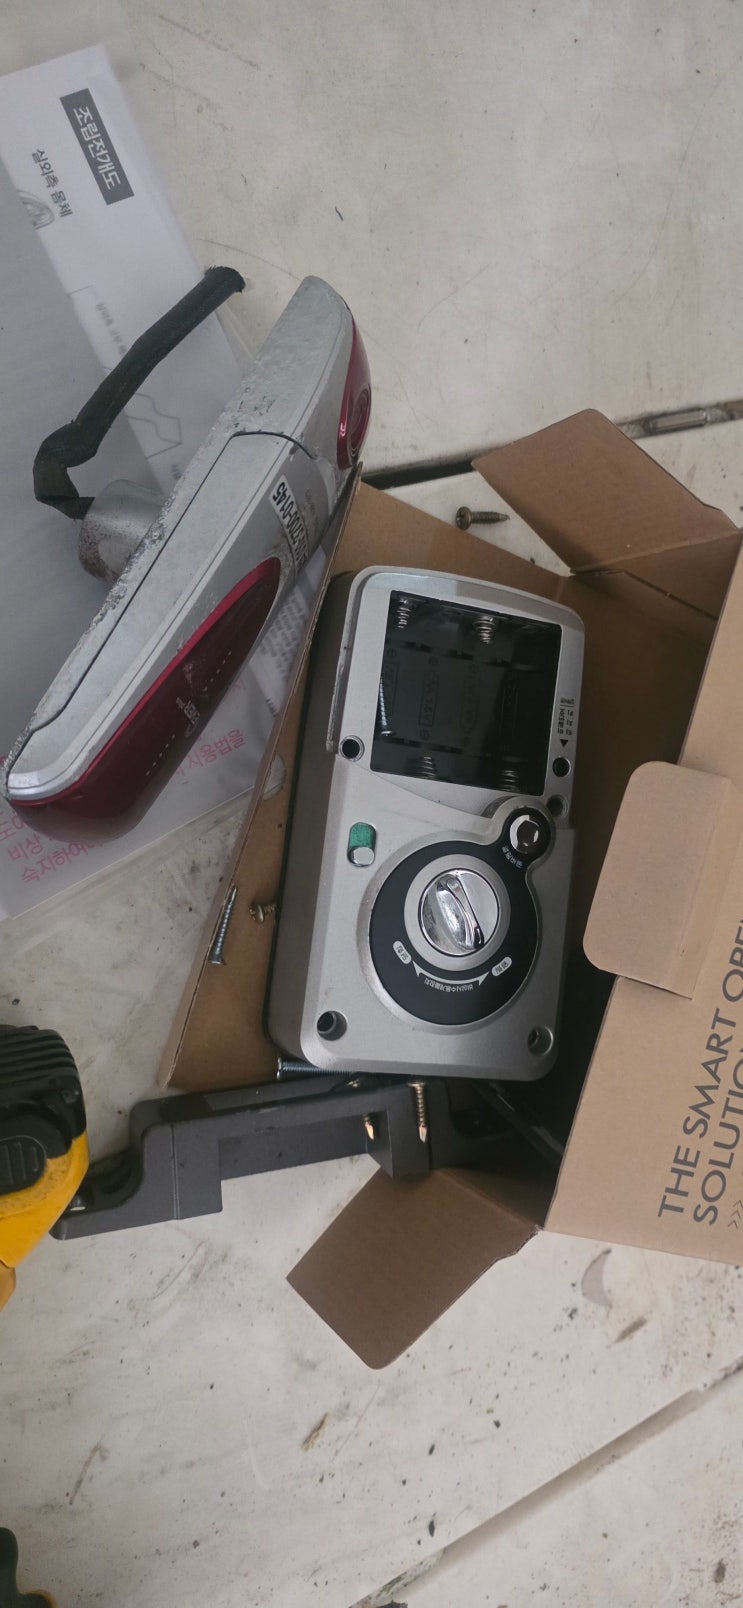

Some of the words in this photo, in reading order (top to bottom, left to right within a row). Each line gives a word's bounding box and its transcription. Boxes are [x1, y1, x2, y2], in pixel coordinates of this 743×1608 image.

[31, 148, 60, 189] 실외측
[49, 189, 73, 218] 몸체
[72, 105, 122, 190] 조립전개도
[7, 833, 44, 861] 비상
[657, 1145, 701, 1218] THE
[682, 1008, 737, 1139] SMART
[693, 1048, 743, 1226] SOLUTI
